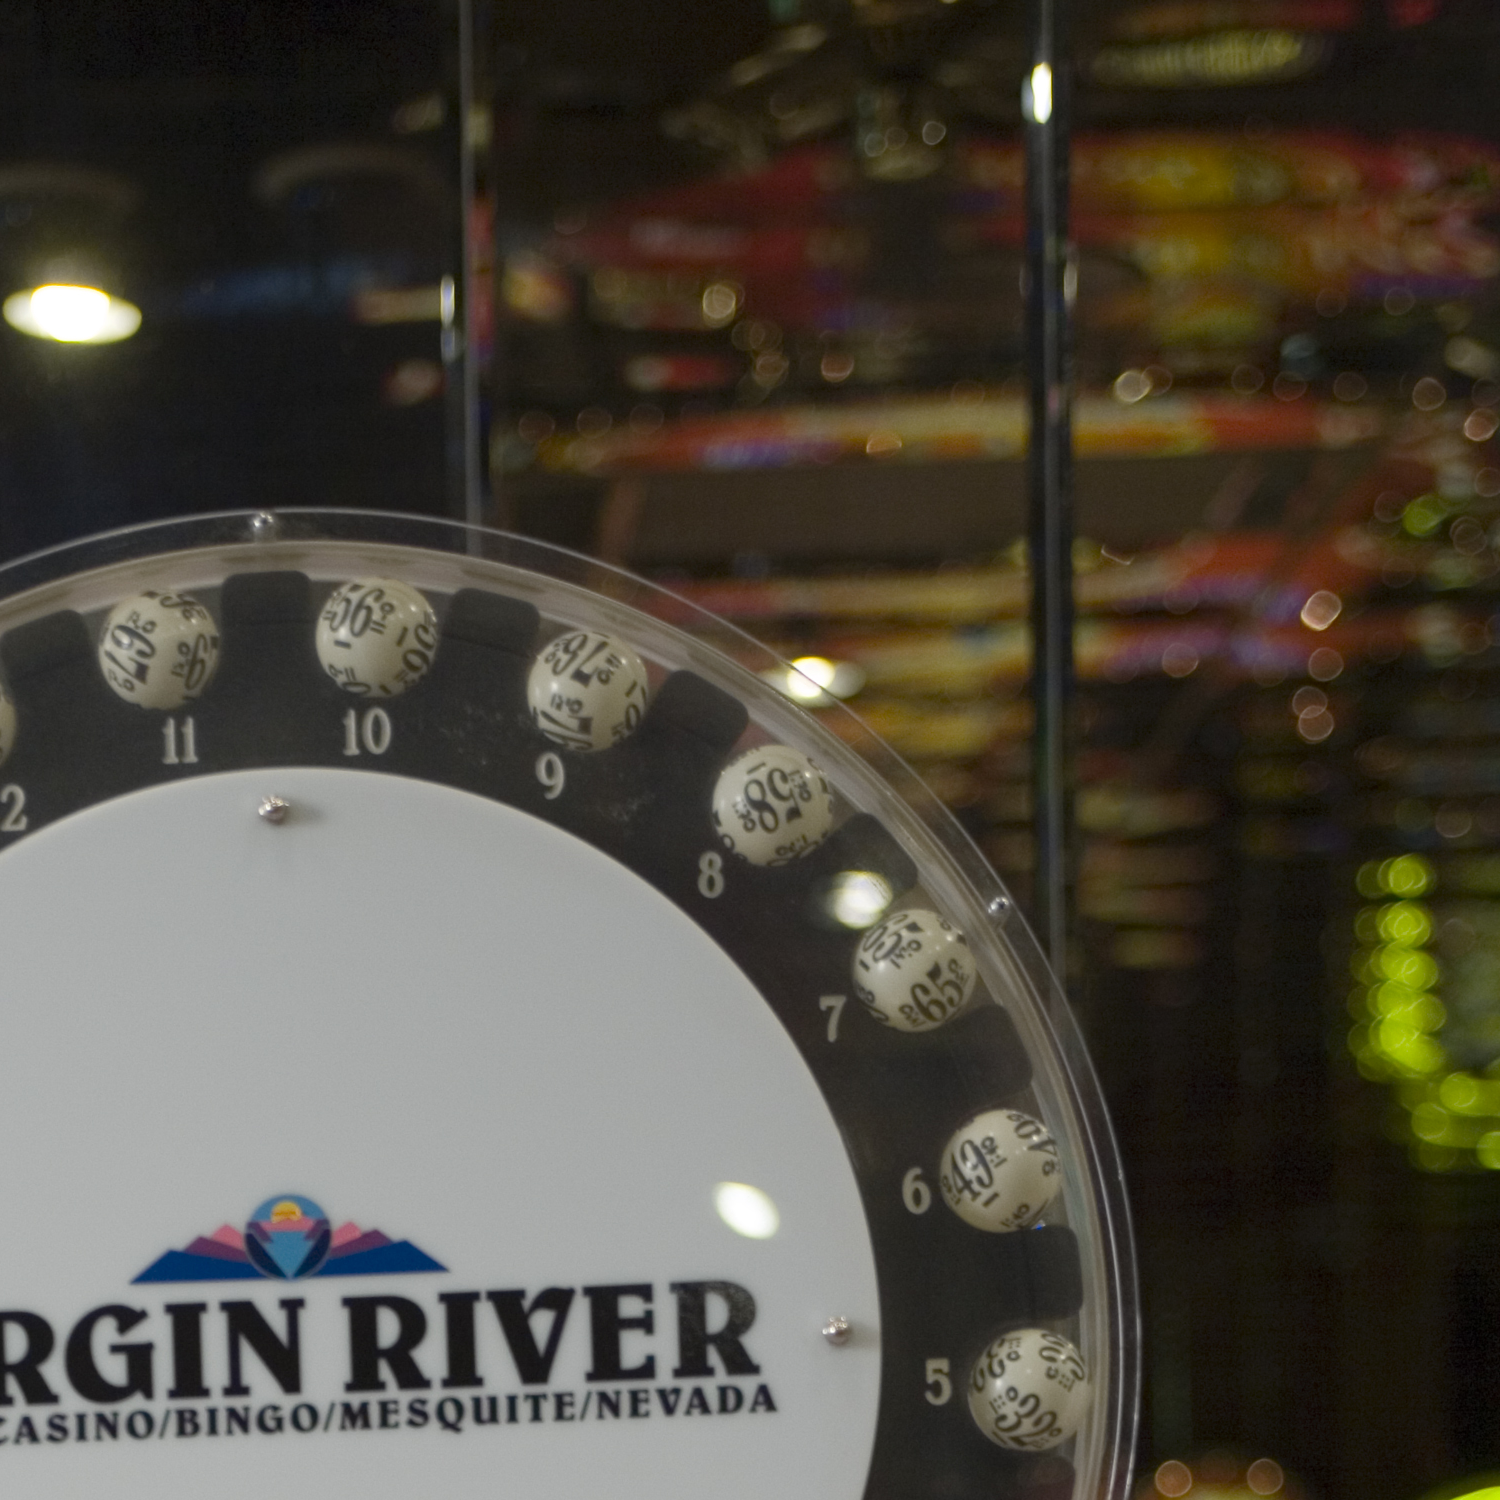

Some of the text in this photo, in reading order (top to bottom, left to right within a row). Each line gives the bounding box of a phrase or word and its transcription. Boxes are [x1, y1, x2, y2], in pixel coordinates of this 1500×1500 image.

[162, 716, 198, 764] 11
[343, 707, 390, 756] 10
[535, 753, 564, 799] 9
[698, 852, 724, 899] 8
[910, 962, 966, 1023] 65
[819, 996, 845, 1042] 7
[902, 1167, 931, 1214] 6
[953, 1139, 994, 1202] 49
[341, 1279, 762, 1395] RIVER
[925, 1359, 952, 1405] 5
